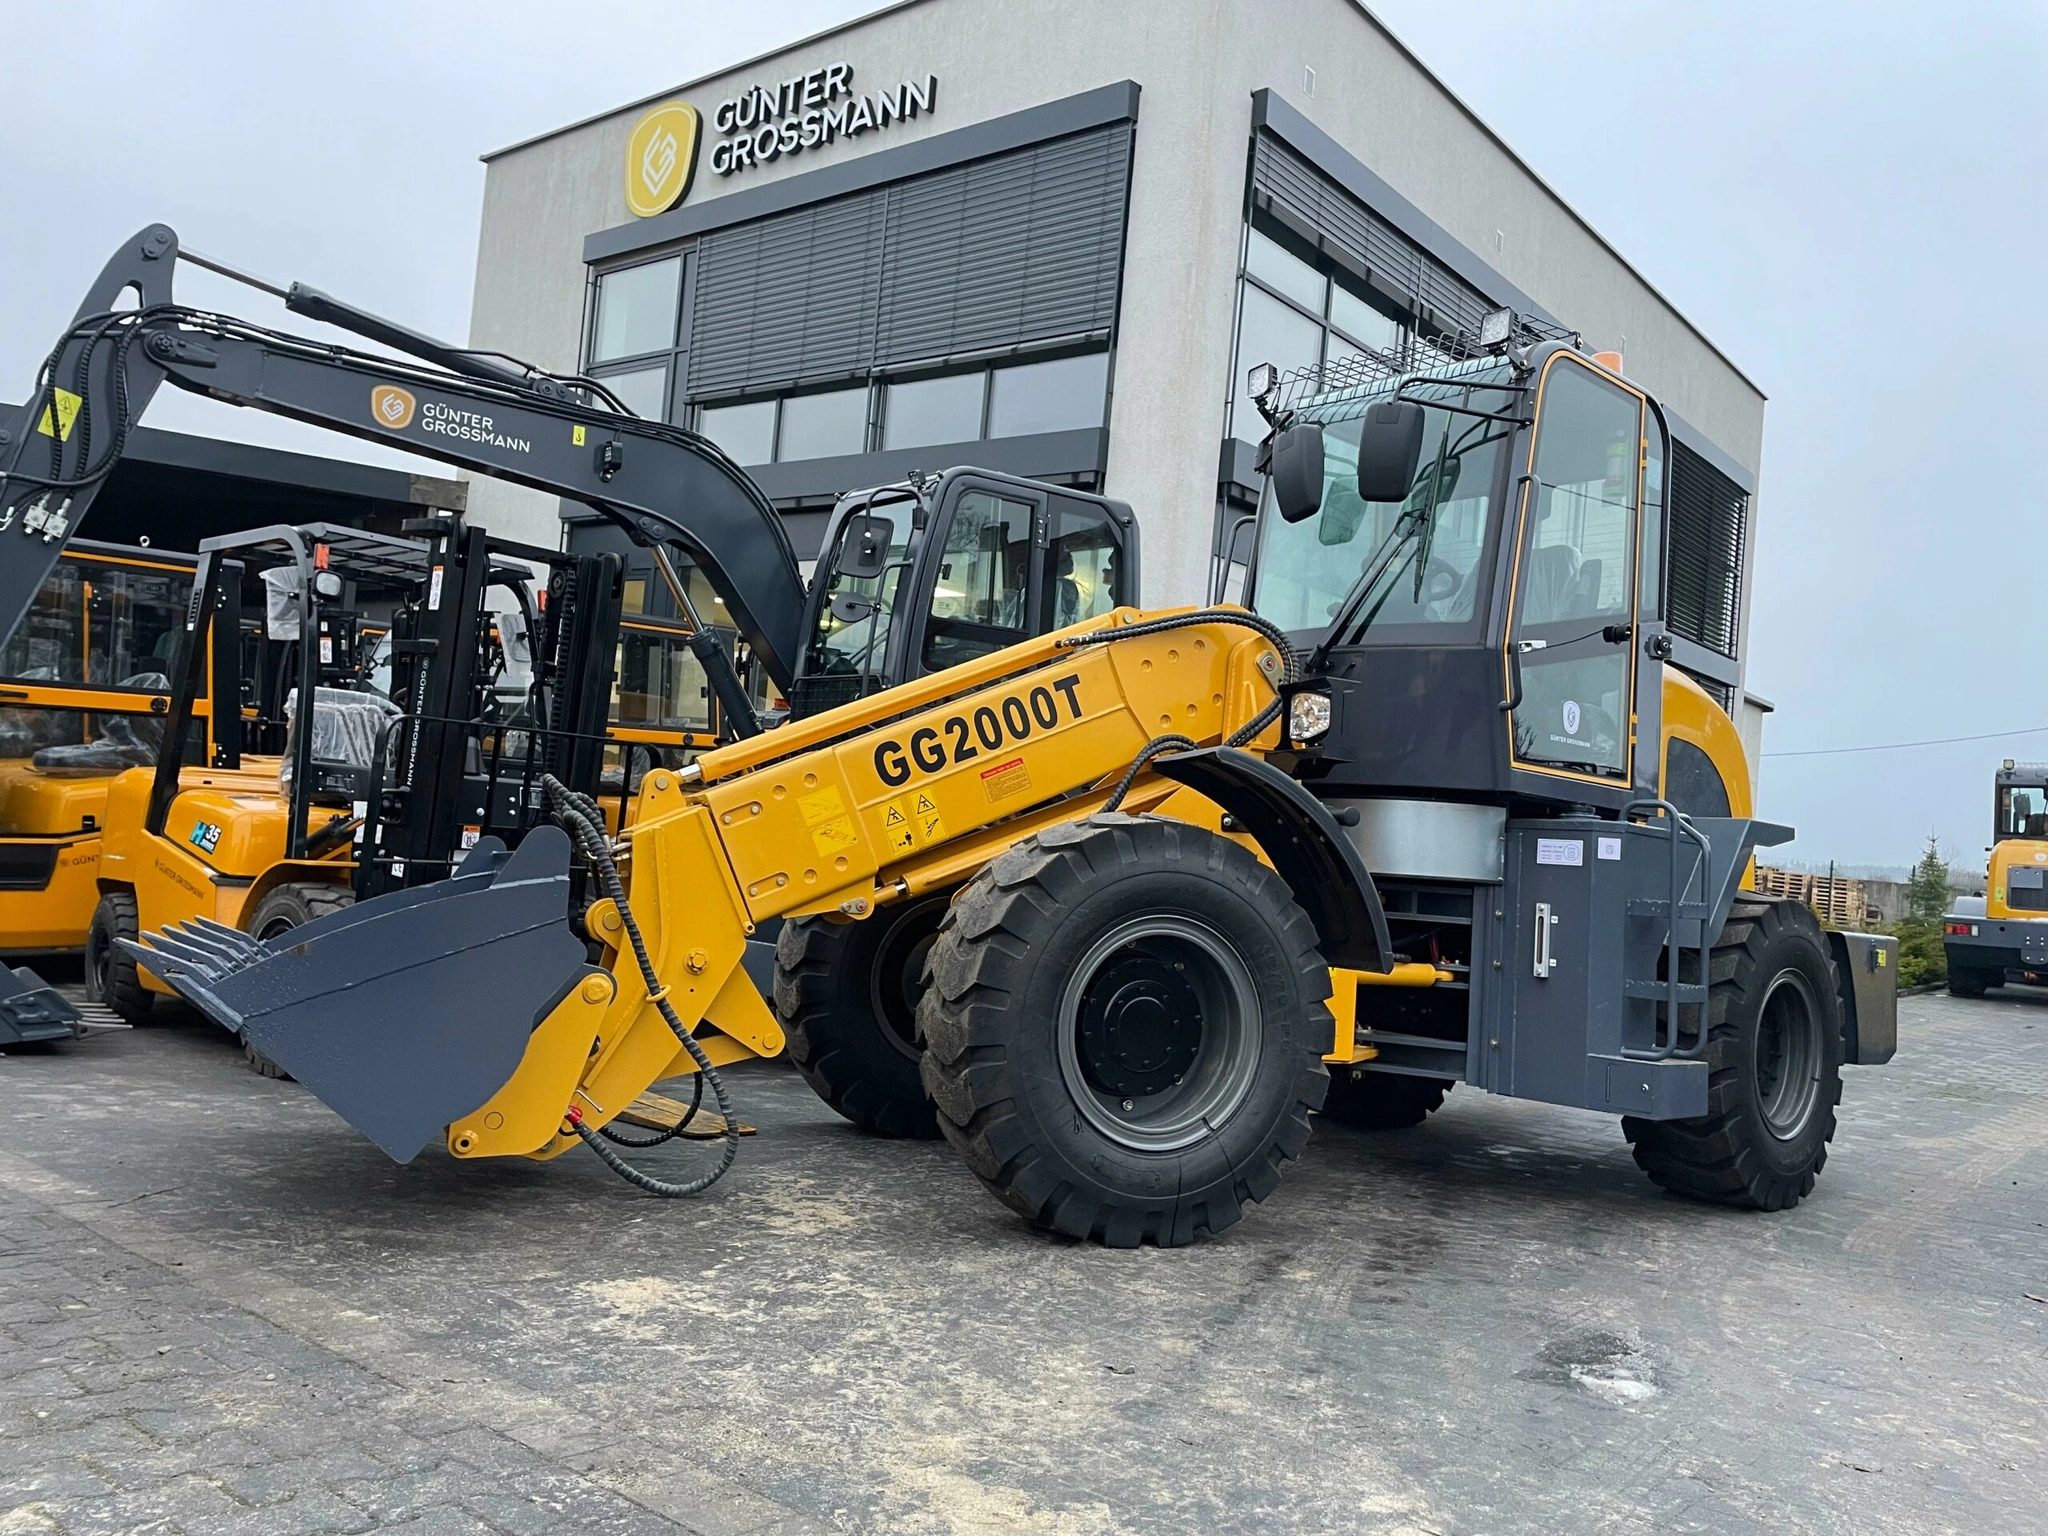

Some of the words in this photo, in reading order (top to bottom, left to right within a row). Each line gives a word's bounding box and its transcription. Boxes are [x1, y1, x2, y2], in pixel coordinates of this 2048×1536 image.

[713, 60, 852, 135] GÜNTER
[709, 73, 936, 176] GROSSMANN
[421, 417, 531, 453] GROSSMANN
[422, 403, 494, 431] GÜNTER
[873, 673, 1083, 788] GG2000T
[205, 824, 222, 843] 35
[72, 854, 99, 866] GÜN
